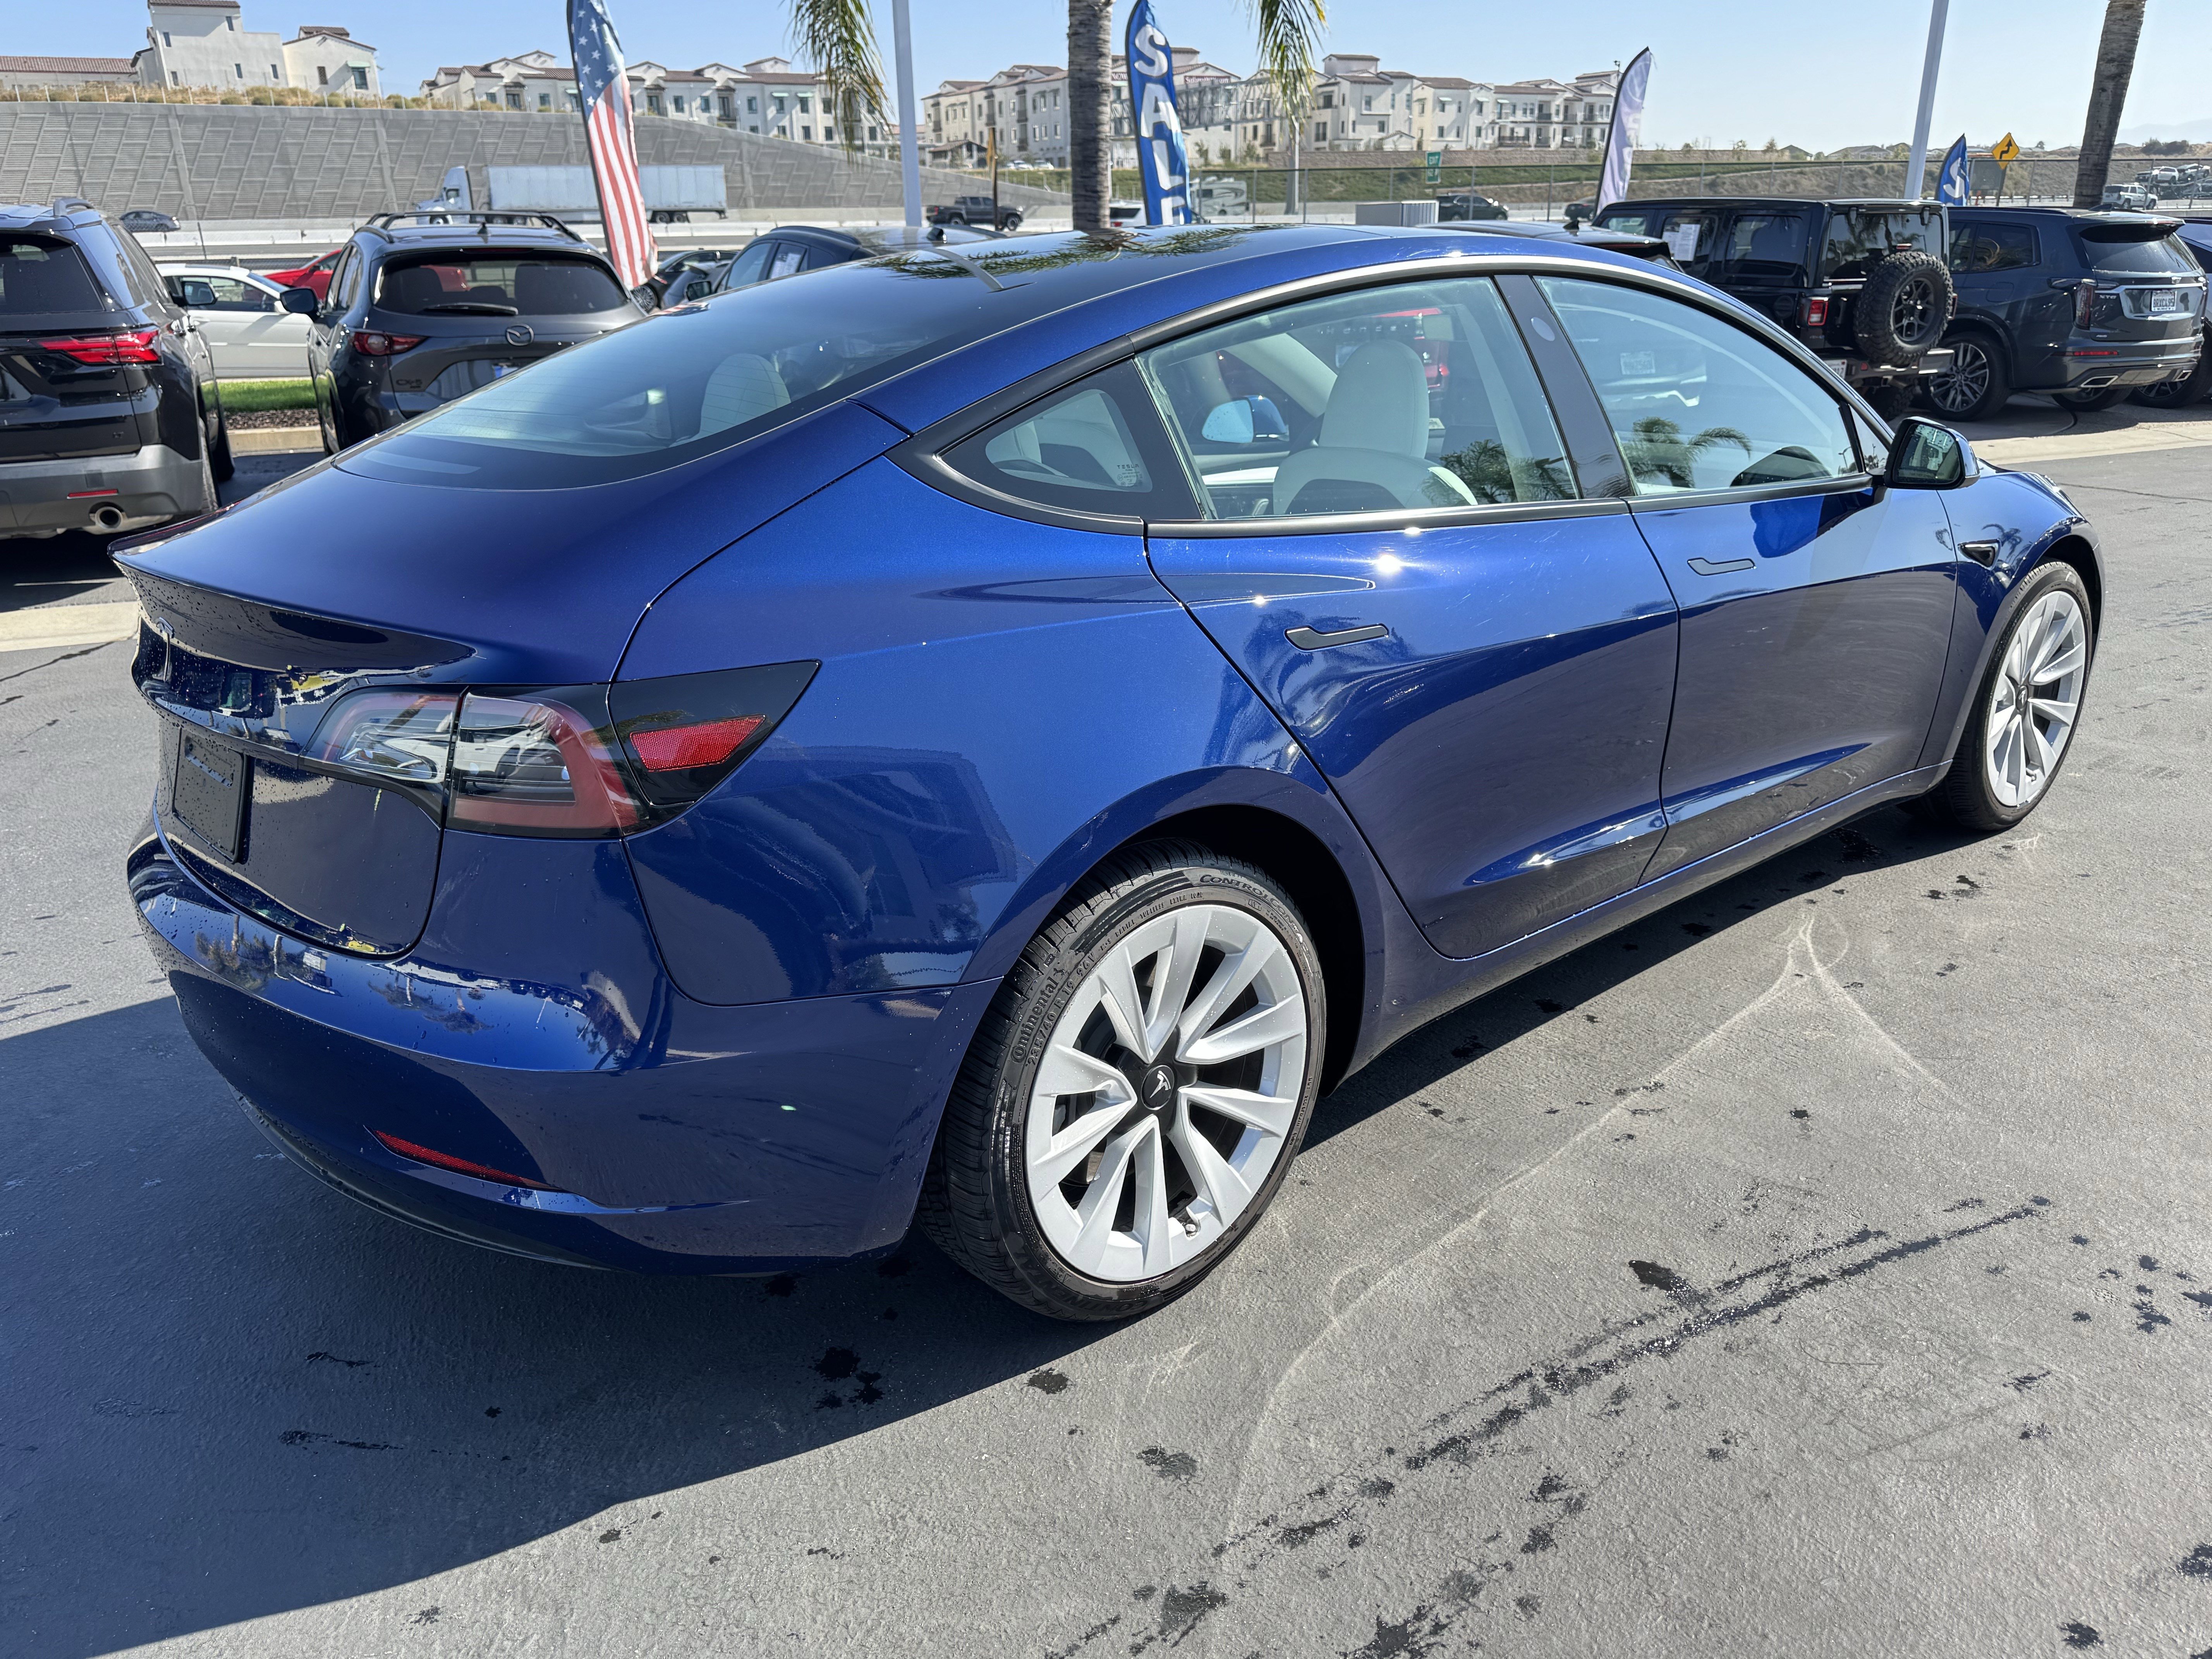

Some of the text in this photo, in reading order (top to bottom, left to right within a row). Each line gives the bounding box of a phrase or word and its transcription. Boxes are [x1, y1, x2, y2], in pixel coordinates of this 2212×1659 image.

[1011, 976, 1059, 1063] Continental
[1027, 1011, 1056, 1066] 235/40
[1054, 998, 1065, 1009] R
[1063, 980, 1075, 996] 19
[1077, 952, 1095, 977] 96V
